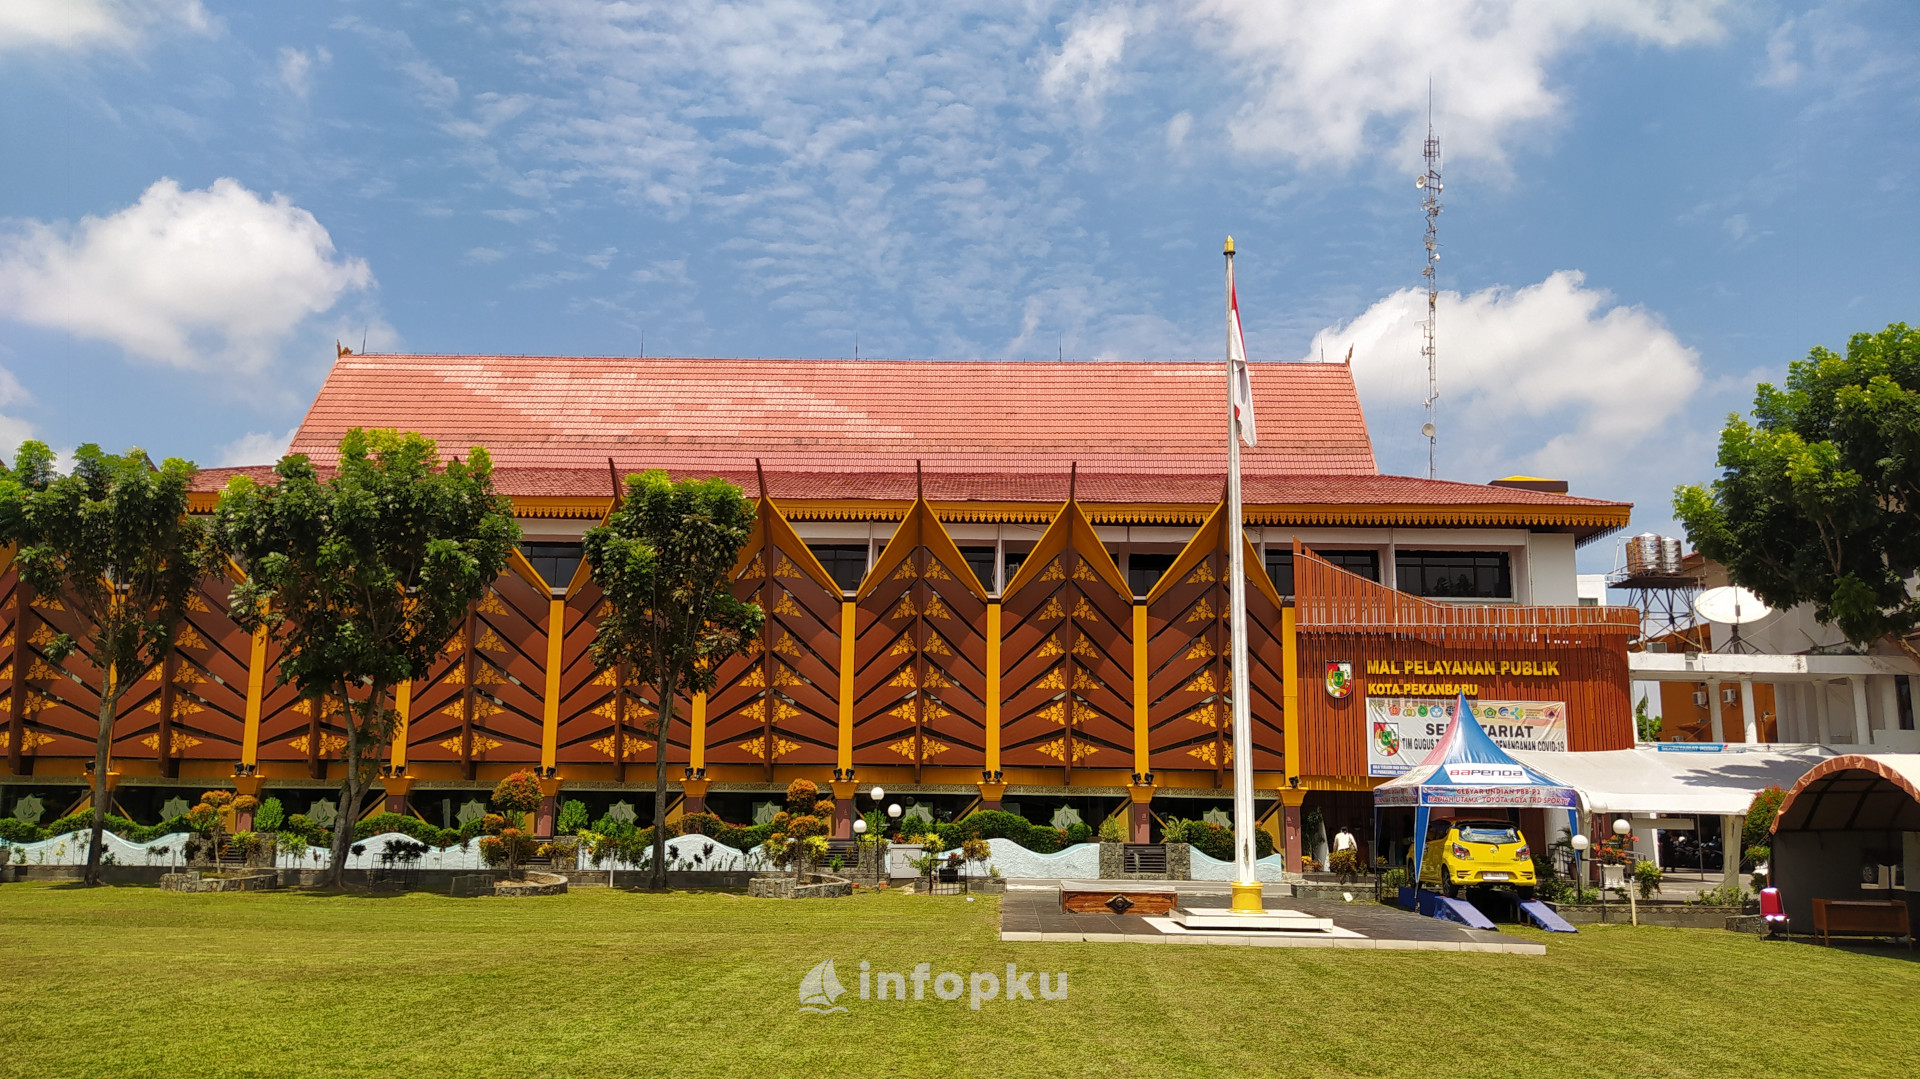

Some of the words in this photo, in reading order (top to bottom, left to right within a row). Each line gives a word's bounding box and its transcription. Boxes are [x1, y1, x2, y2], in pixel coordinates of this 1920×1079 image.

[1366, 660, 1400, 674] MAL
[1404, 660, 1496, 676] PELAYANAN
[1500, 660, 1560, 676] PUBLIK
[1368, 684, 1400, 695] KOTA
[1404, 684, 1478, 696] PEKANBARU
[1426, 723, 1534, 738] SETARIAT
[1402, 738, 1412, 750] TIM
[1414, 738, 1434, 750] GUGUS
[1538, 740, 1564, 752] COVID-19
[1544, 797, 1570, 805] SPORTY
